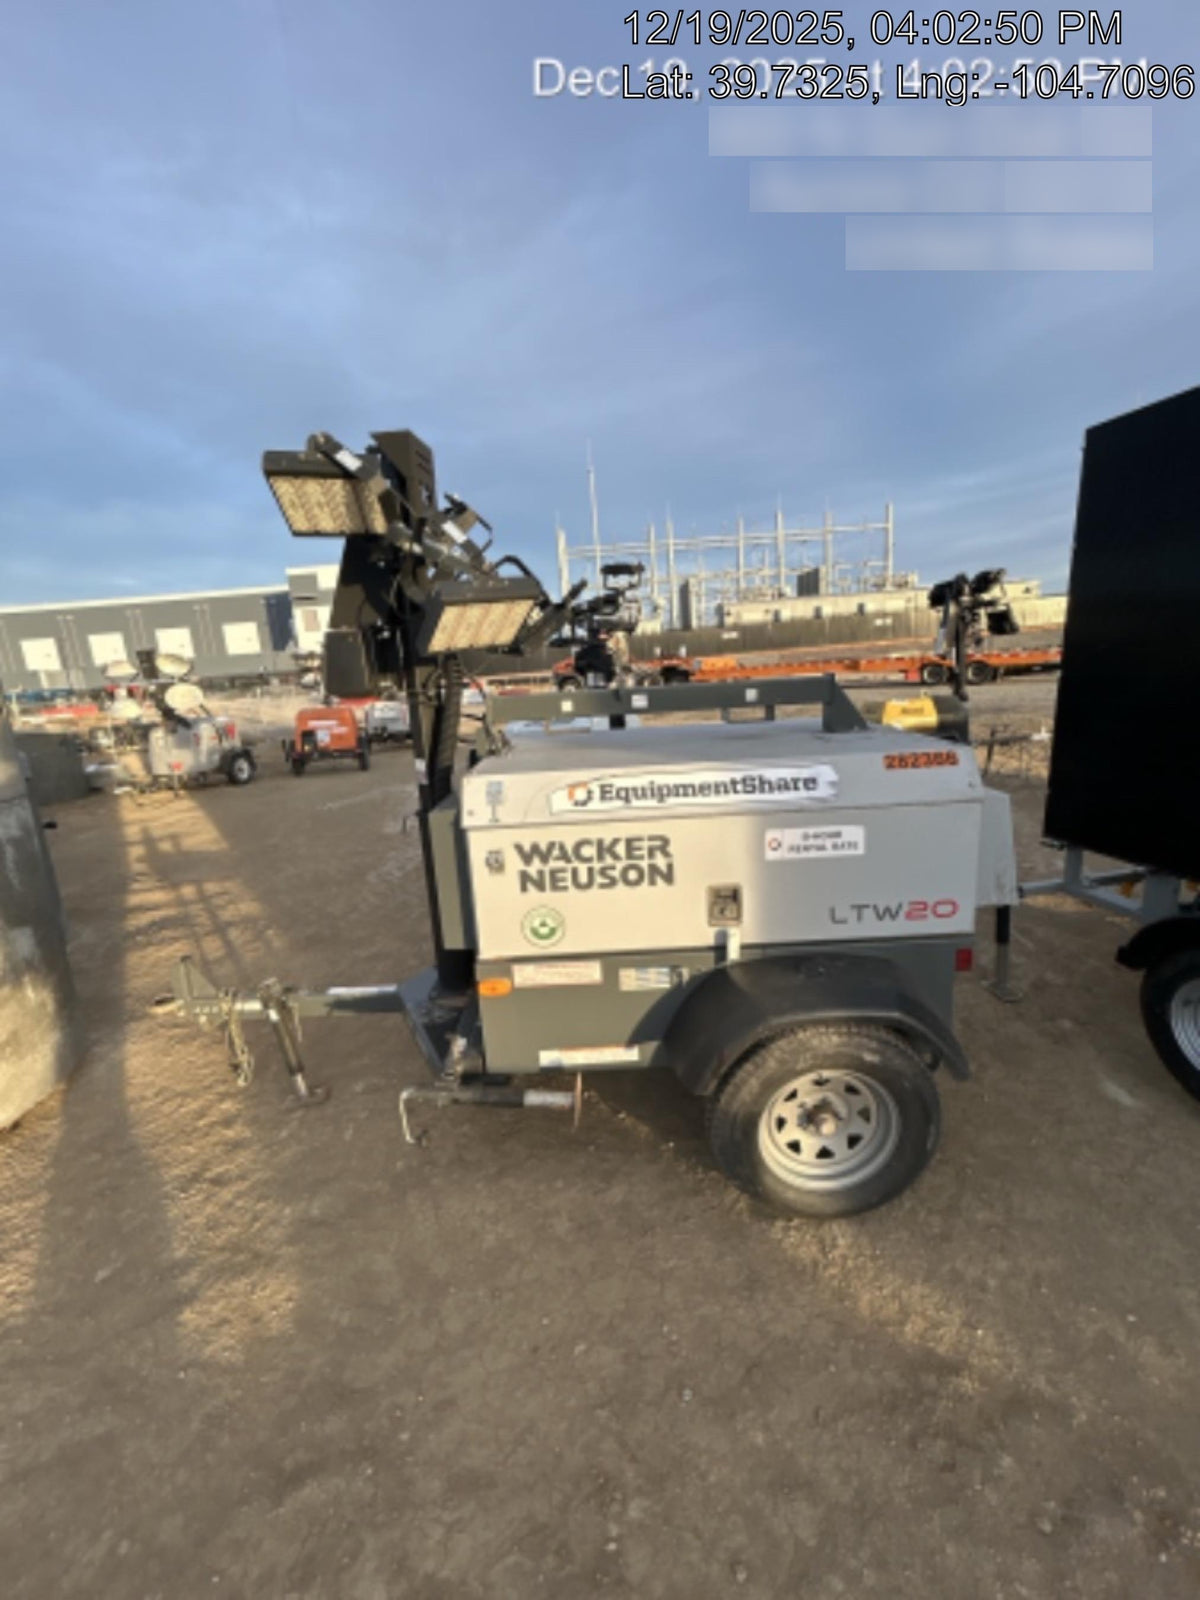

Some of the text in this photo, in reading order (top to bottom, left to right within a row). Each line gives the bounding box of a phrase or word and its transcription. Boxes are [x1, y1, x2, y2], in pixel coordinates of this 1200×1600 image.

[598, 775, 819, 804] EquipmentShare
[513, 834, 673, 867] WACKER
[517, 861, 675, 893] NEUSON
[829, 898, 960, 925] LTW20
